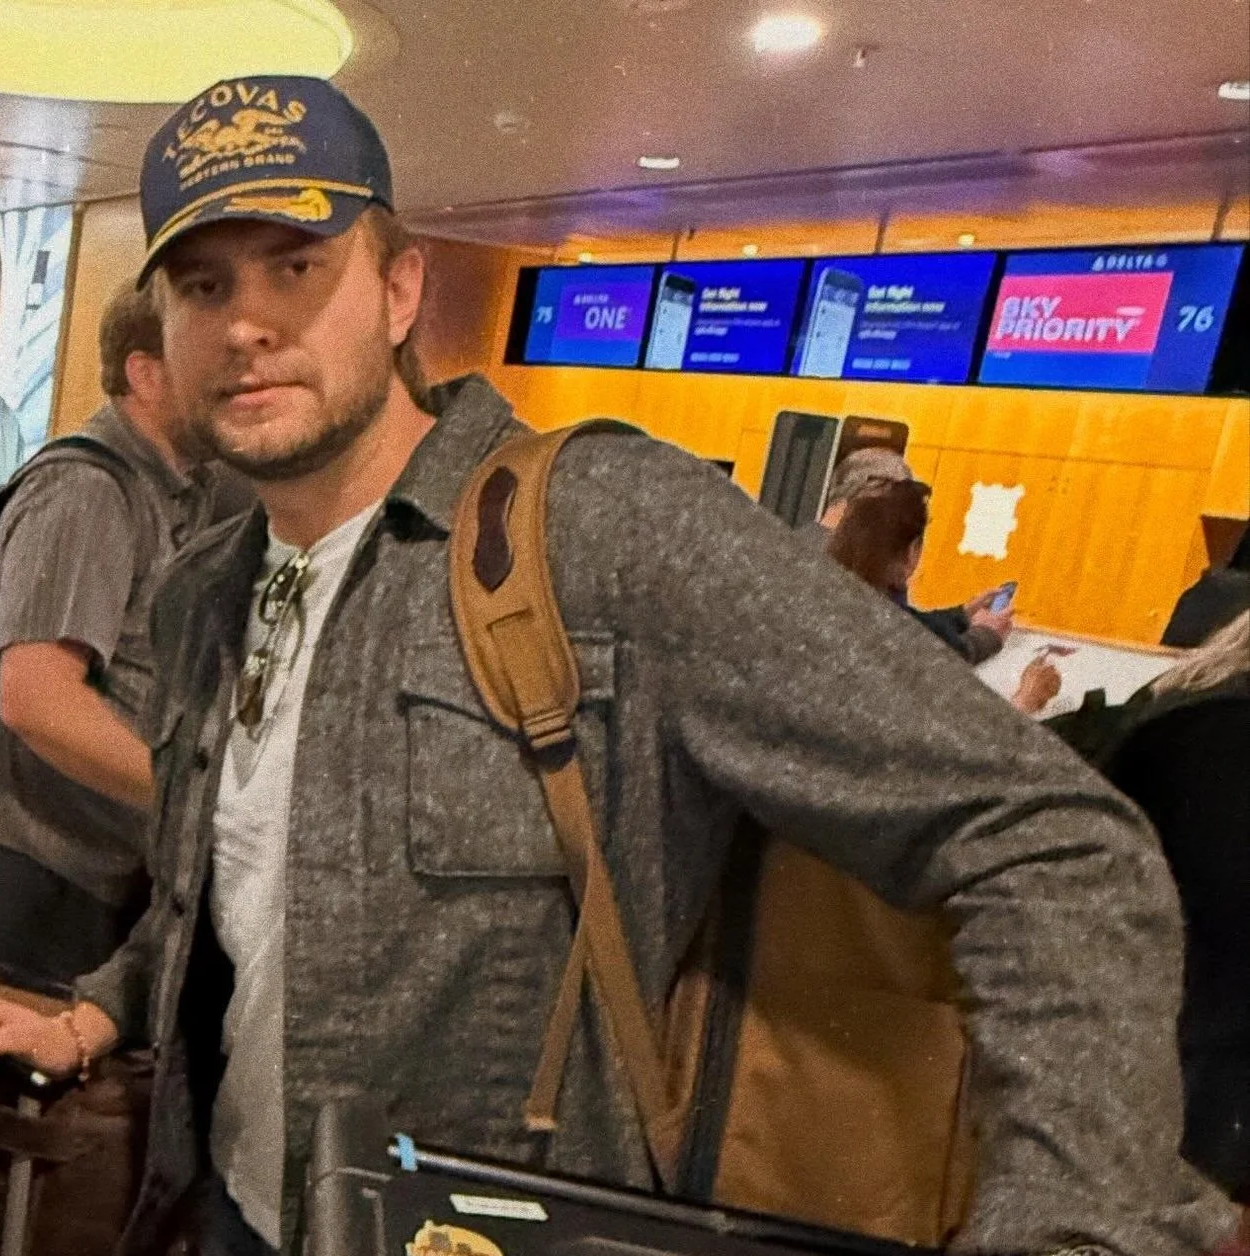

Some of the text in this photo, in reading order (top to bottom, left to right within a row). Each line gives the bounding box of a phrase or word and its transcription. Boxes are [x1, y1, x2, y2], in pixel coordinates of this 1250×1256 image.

[161, 82, 307, 163] TECOVAS
[585, 306, 627, 330] ONE
[1002, 296, 1062, 318] SKY
[1177, 305, 1214, 333] 76
[995, 316, 1139, 343] PRIORITY
